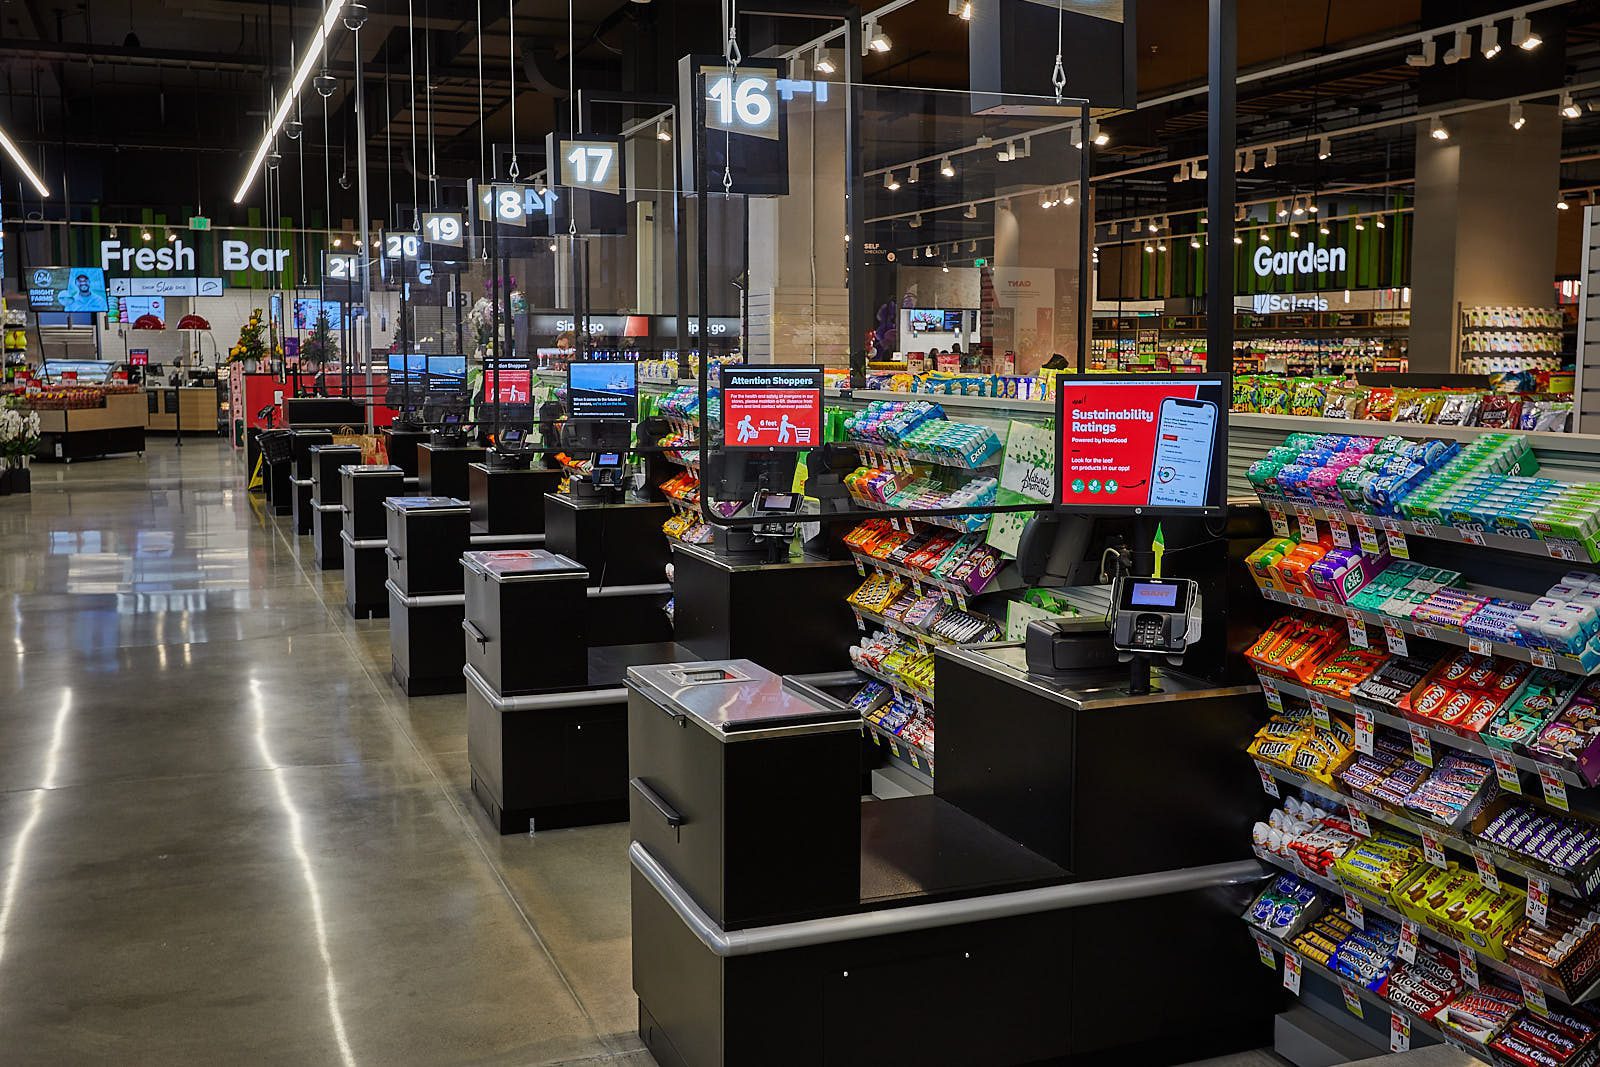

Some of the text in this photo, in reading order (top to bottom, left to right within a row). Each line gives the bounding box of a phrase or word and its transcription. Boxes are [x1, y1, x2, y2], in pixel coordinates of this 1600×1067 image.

[706, 76, 772, 125] 16
[568, 147, 613, 182] 17
[483, 190, 522, 219] 18
[426, 217, 460, 241] 19
[101, 240, 290, 272] Fresh Bar
[387, 236, 417, 257] 20
[330, 258, 356, 278] 21
[1254, 242, 1346, 277] Garden
[556, 320, 604, 334] Sip go
[688, 321, 726, 334] ip go
[731, 376, 813, 386] Attention Shoppers
[1072, 409, 1154, 422] Sustainability
[1072, 422, 1116, 434] Ratings
[970, 443, 988, 463] Extra
[1347, 577, 1362, 590] tac
[1348, 570, 1360, 581] tic
[1434, 596, 1464, 606] mentos
[1474, 615, 1508, 628] mentos
[1530, 900, 1545, 915] 3/$3
[1416, 956, 1452, 979] ounds
[1392, 973, 1440, 1001] Mounds
[1388, 986, 1430, 1014] Mounds
[1519, 1021, 1574, 1049] Peanut Chews
[1565, 1017, 1591, 1033] Chews
[1501, 1038, 1557, 1067] Peanut Chews
